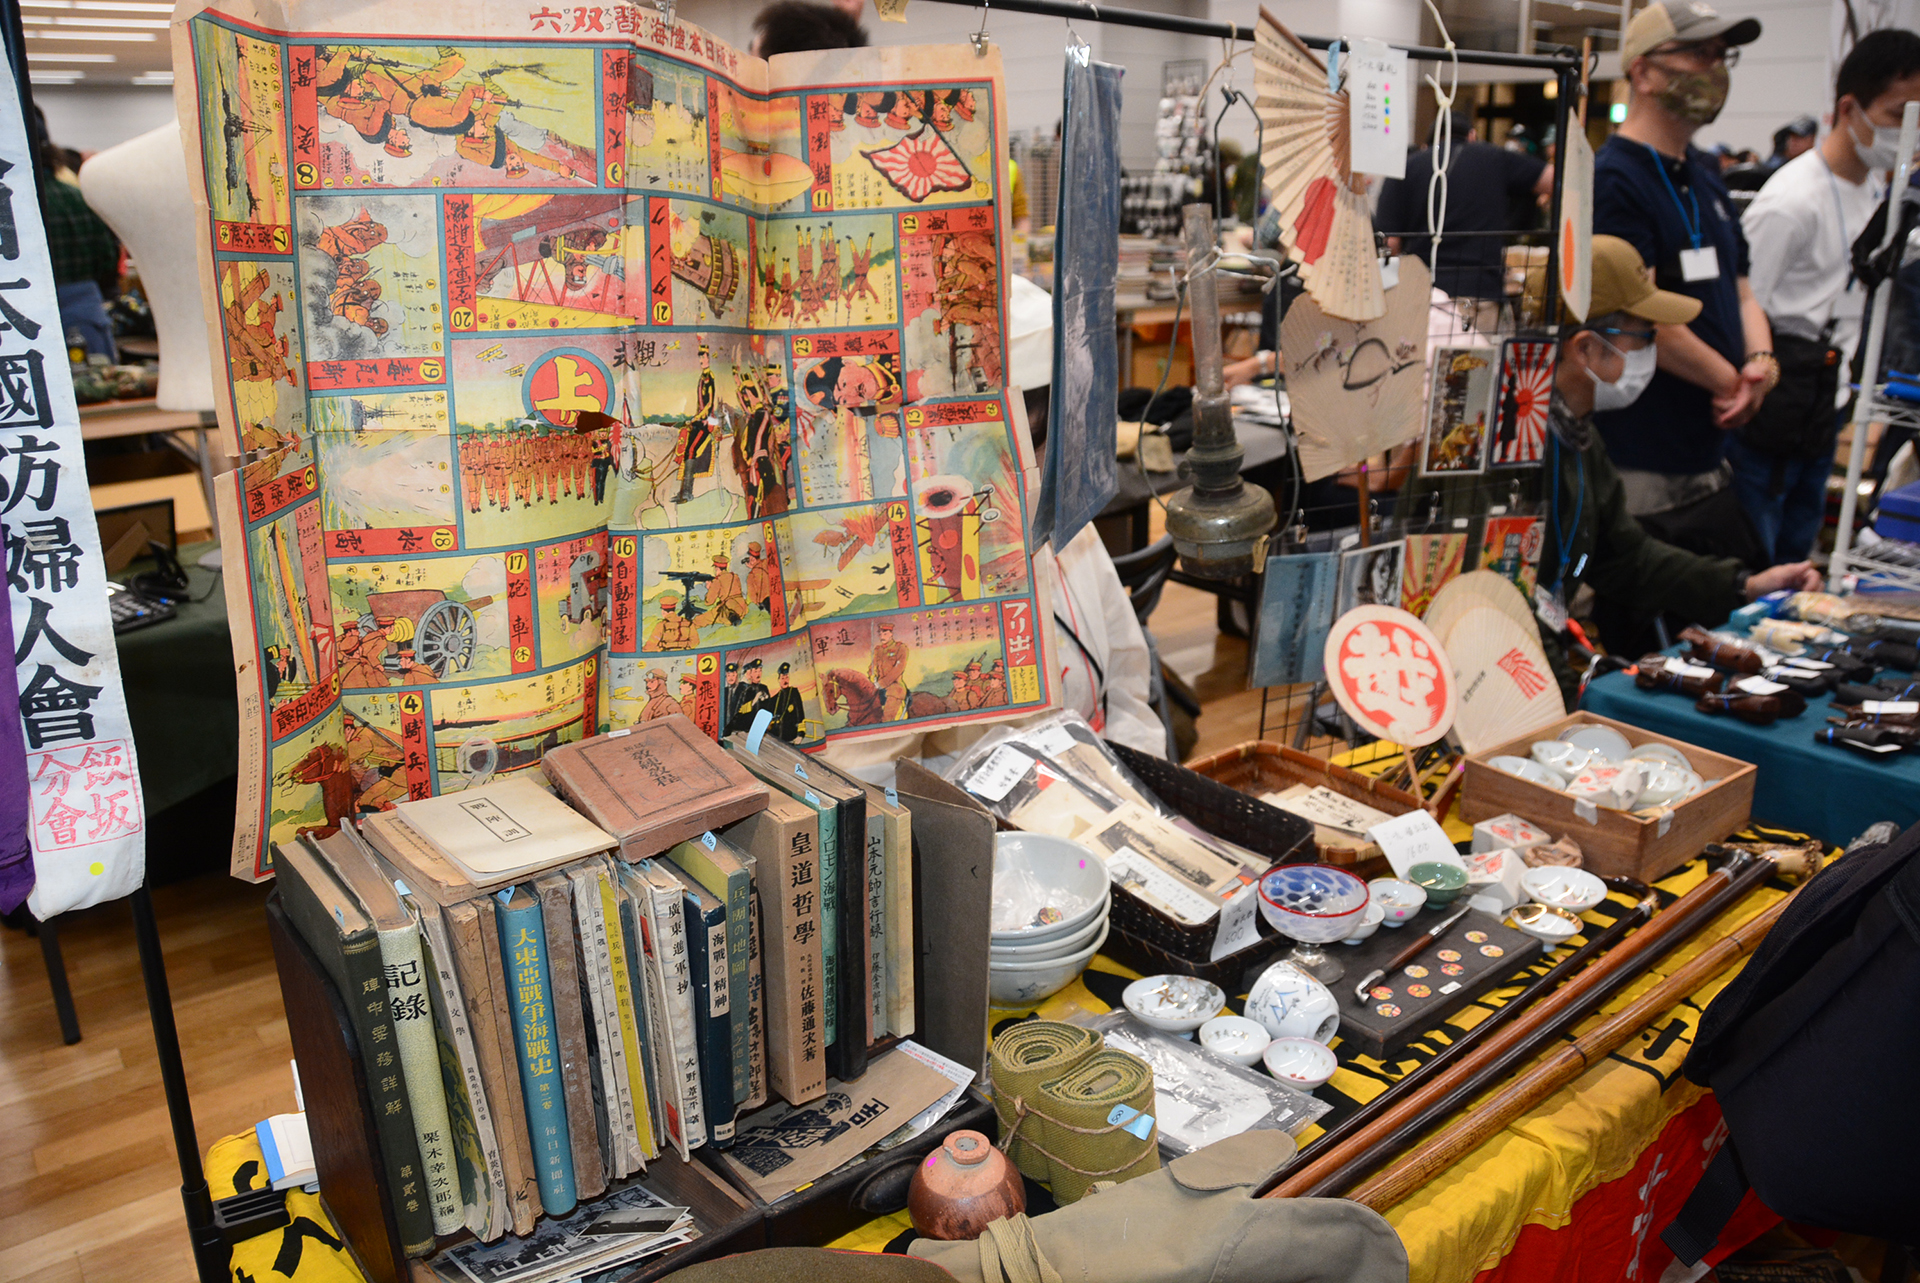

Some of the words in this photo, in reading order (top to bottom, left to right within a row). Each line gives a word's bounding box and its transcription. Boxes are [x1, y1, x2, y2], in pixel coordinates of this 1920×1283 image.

[297, 166, 313, 184] 8
[904, 217, 916, 230] 12
[453, 312, 472, 327] 20
[656, 305, 669, 321] 21
[796, 339, 808, 353] 23
[423, 361, 439, 378] 19
[908, 410, 921, 423] 13
[306, 470, 316, 485] 6
[890, 506, 905, 519] 14
[434, 532, 451, 547] 18
[616, 540, 633, 556] 16
[508, 554, 525, 571] 17
[1004, 601, 1031, 665] フリ出シ
[586, 660, 595, 675] 3
[702, 657, 712, 673] 2
[404, 695, 418, 712] 4
[790, 831, 816, 946] 皇道哲學
[712, 931, 729, 1011] 海戰の精神
[511, 927, 554, 1077] 大東亞戰爭海戰史
[801, 984, 817, 1063] 佐藤通次著
